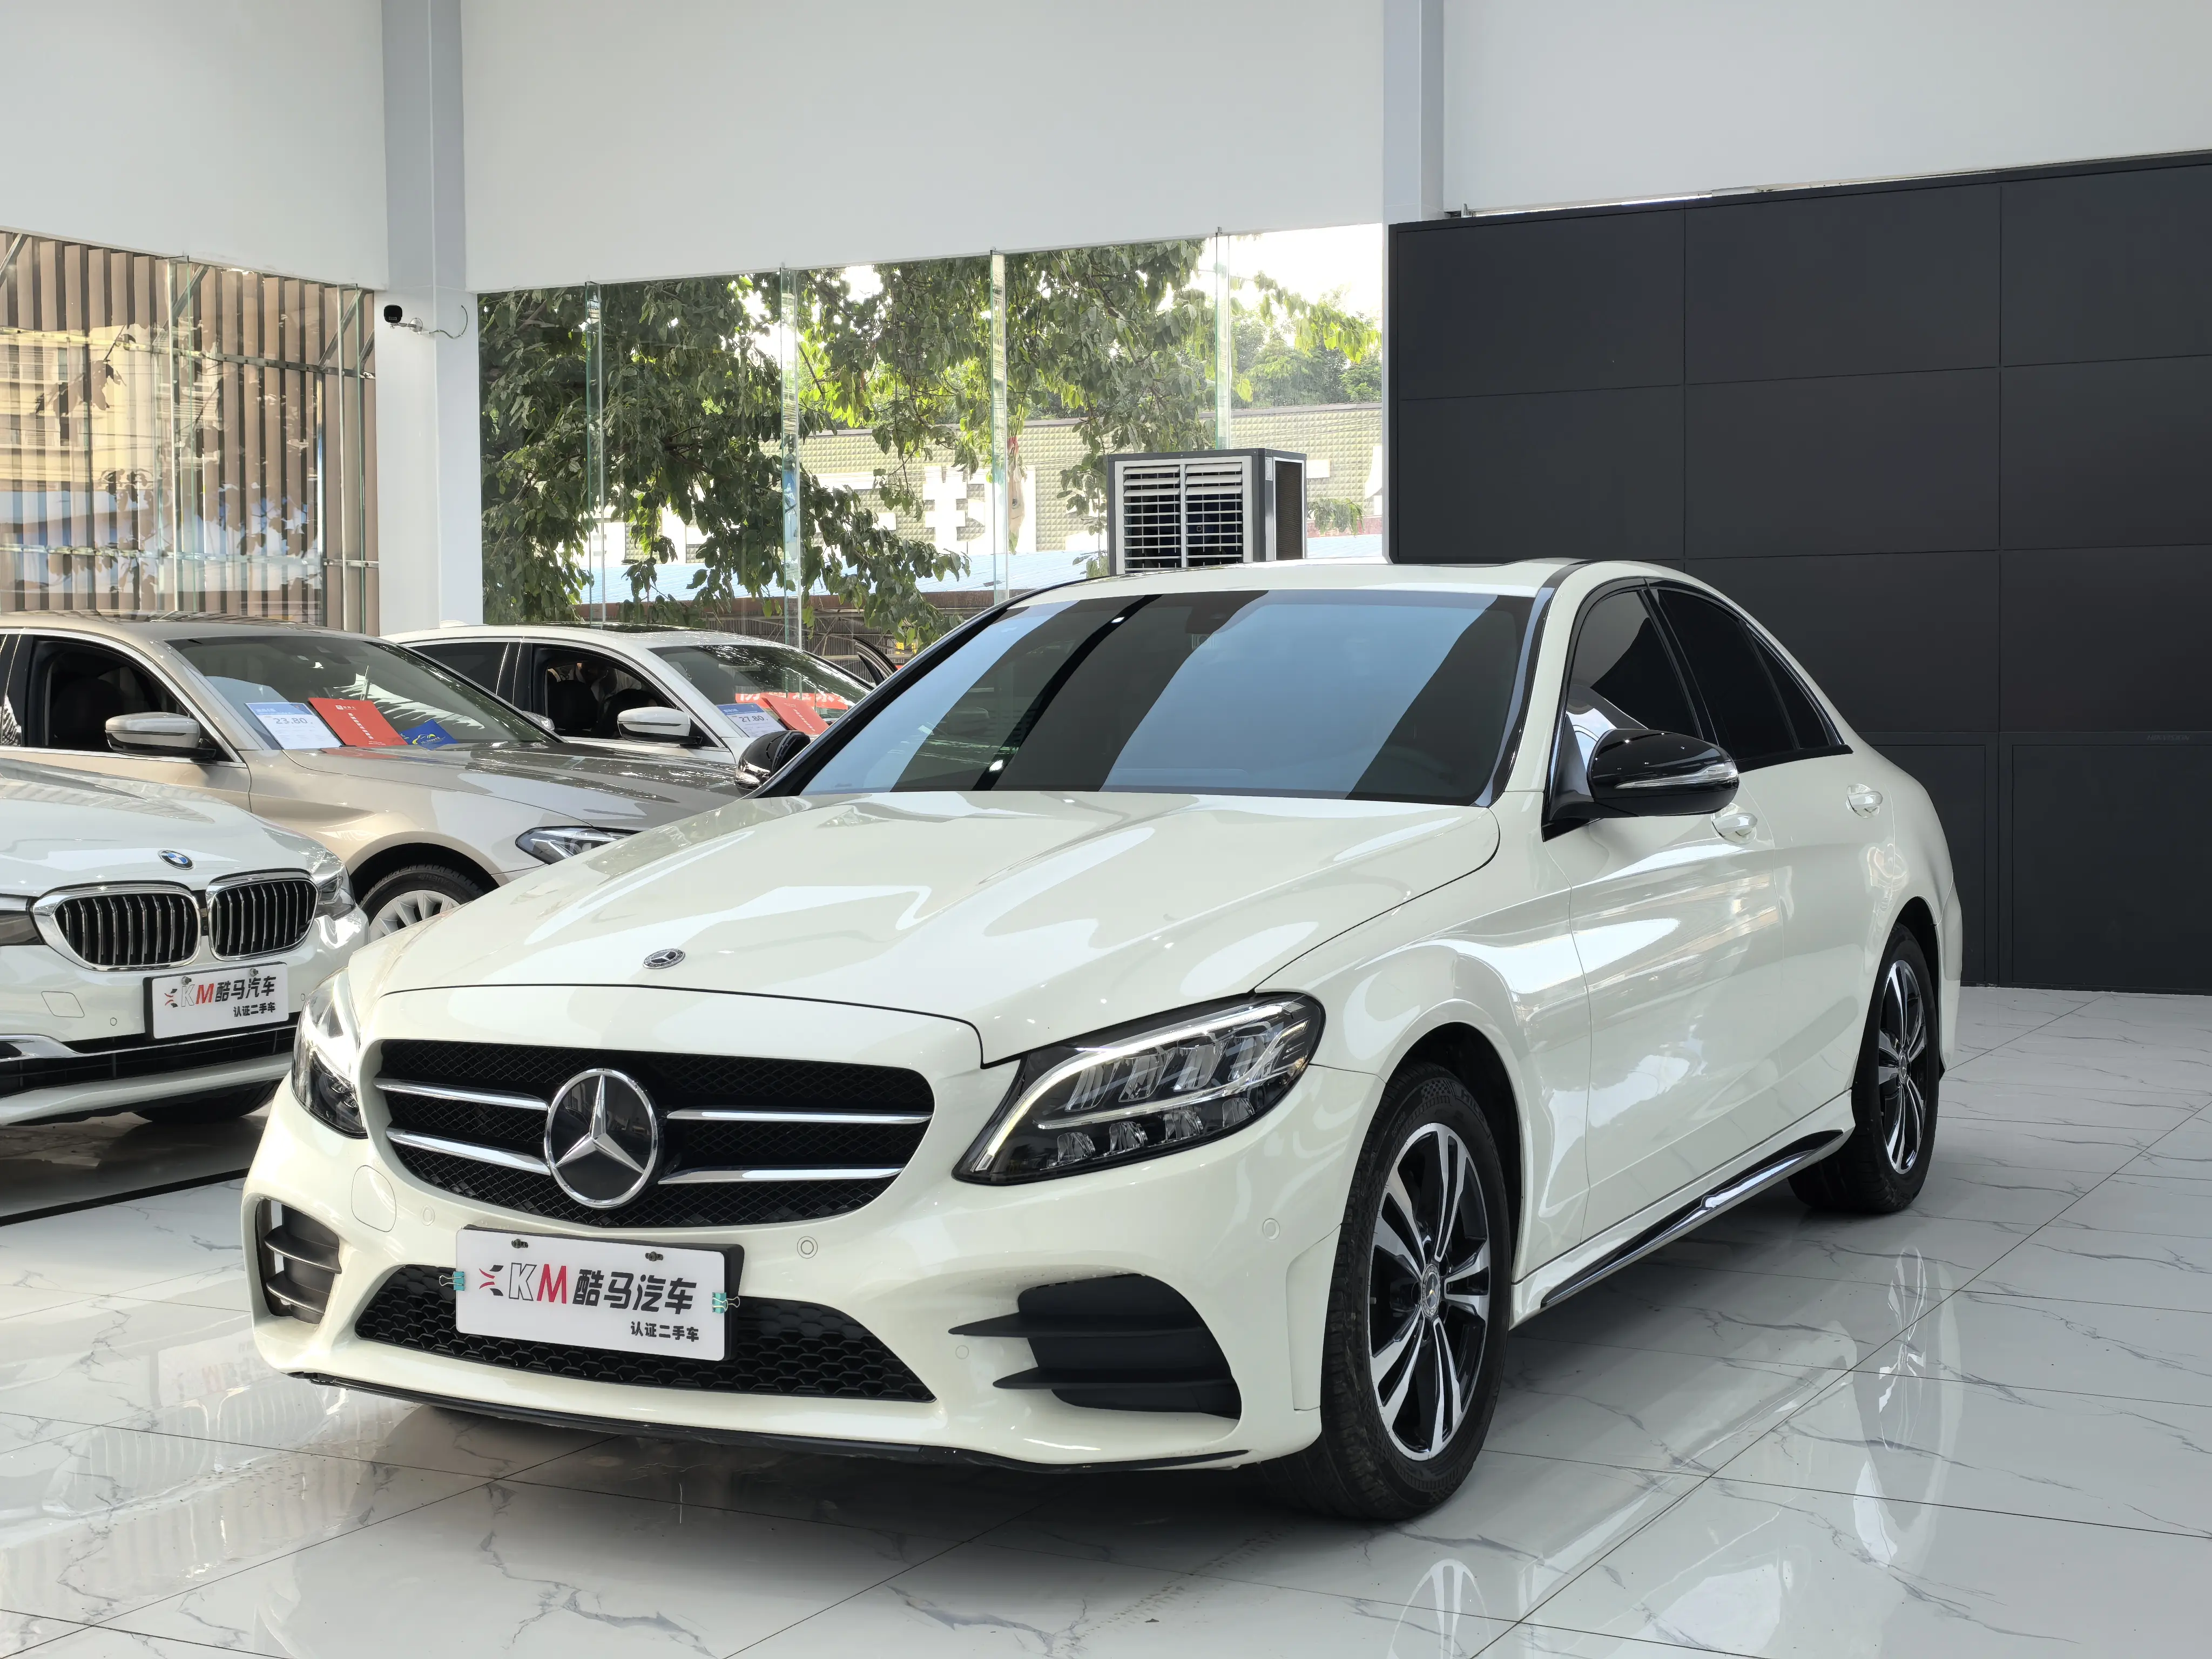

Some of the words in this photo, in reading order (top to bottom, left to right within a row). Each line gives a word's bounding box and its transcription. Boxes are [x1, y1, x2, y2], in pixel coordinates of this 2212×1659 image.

[233, 1002, 276, 1017] 认证二手车
[631, 1321, 699, 1343] 认证二手车
